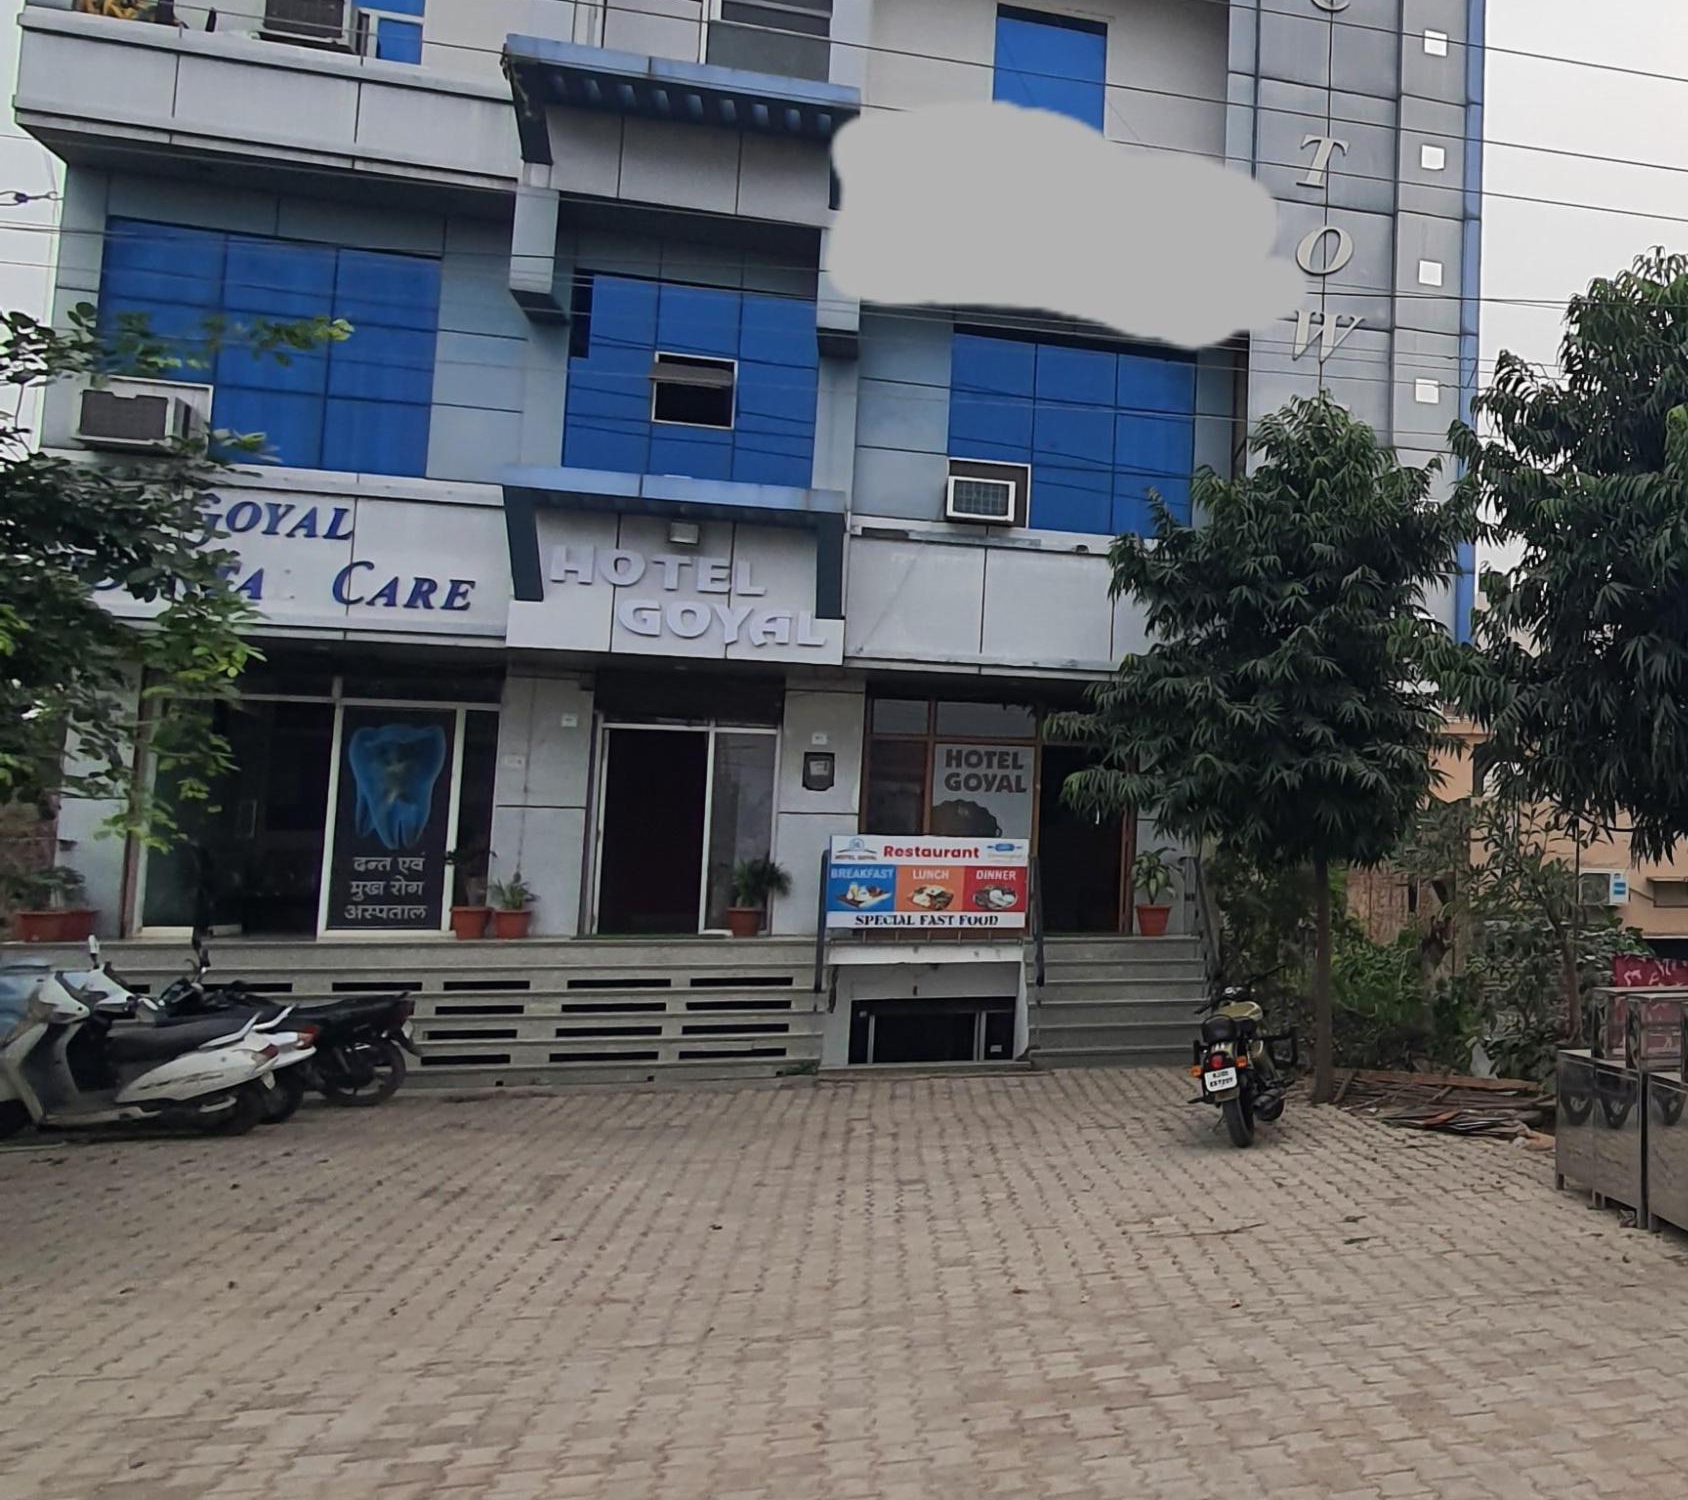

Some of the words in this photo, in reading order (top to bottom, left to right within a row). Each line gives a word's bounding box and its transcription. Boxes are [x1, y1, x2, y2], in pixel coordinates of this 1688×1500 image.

[184, 492, 353, 549] GOYAL
[549, 545, 767, 597] HOTEL
[332, 561, 477, 611] CARE
[617, 598, 827, 647] GOYAL
[945, 749, 1024, 770] HOTEL
[944, 772, 1028, 793] GOYAL
[883, 845, 980, 859] Restaurant
[397, 852, 425, 875] एवं
[831, 868, 894, 879] BREAKFAST
[912, 869, 949, 880] LUNCH
[976, 870, 1017, 881] DINNER
[350, 881, 387, 902] मुख
[390, 875, 425, 896] रोग
[344, 905, 428, 919] अस्पताल
[855, 914, 915, 926] SPECIAL
[920, 915, 955, 926] FAST
[959, 915, 999, 926] FOOD
